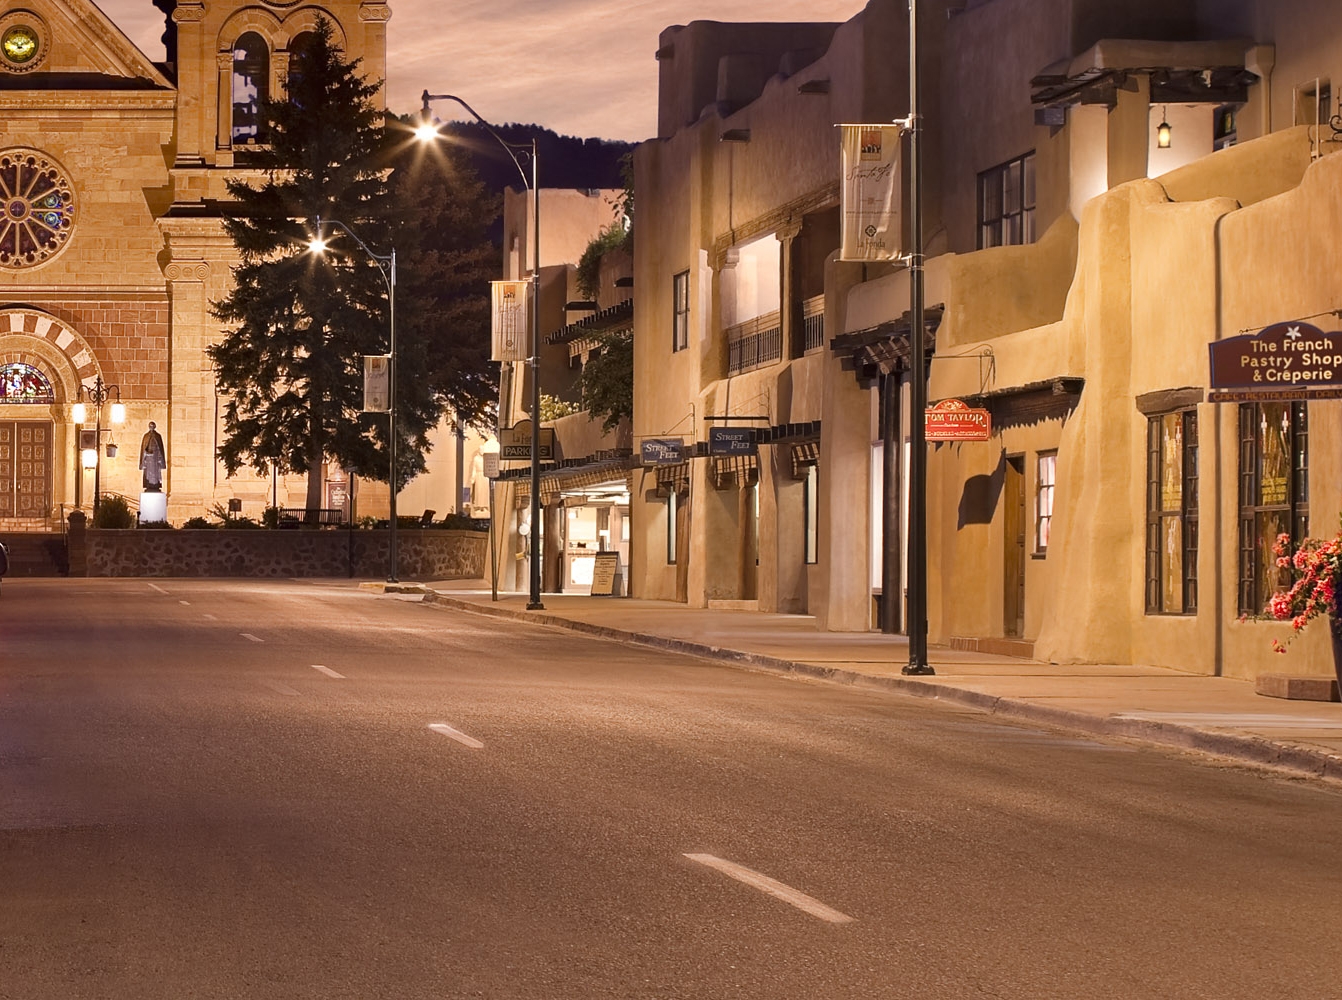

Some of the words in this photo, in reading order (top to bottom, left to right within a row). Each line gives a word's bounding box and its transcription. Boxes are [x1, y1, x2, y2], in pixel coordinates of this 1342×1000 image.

[1250, 340, 1277, 352] The
[1283, 338, 1333, 351] French
[1240, 355, 1293, 369] Pastry
[1302, 353, 1342, 367] Shop
[1252, 370, 1262, 382] &
[924, 413, 945, 425] TOM
[947, 413, 987, 428] TAYLOR
[715, 432, 743, 441] STREET
[645, 443, 674, 452] STREET
[730, 440, 750, 449] FEET
[659, 451, 679, 460] FEET
